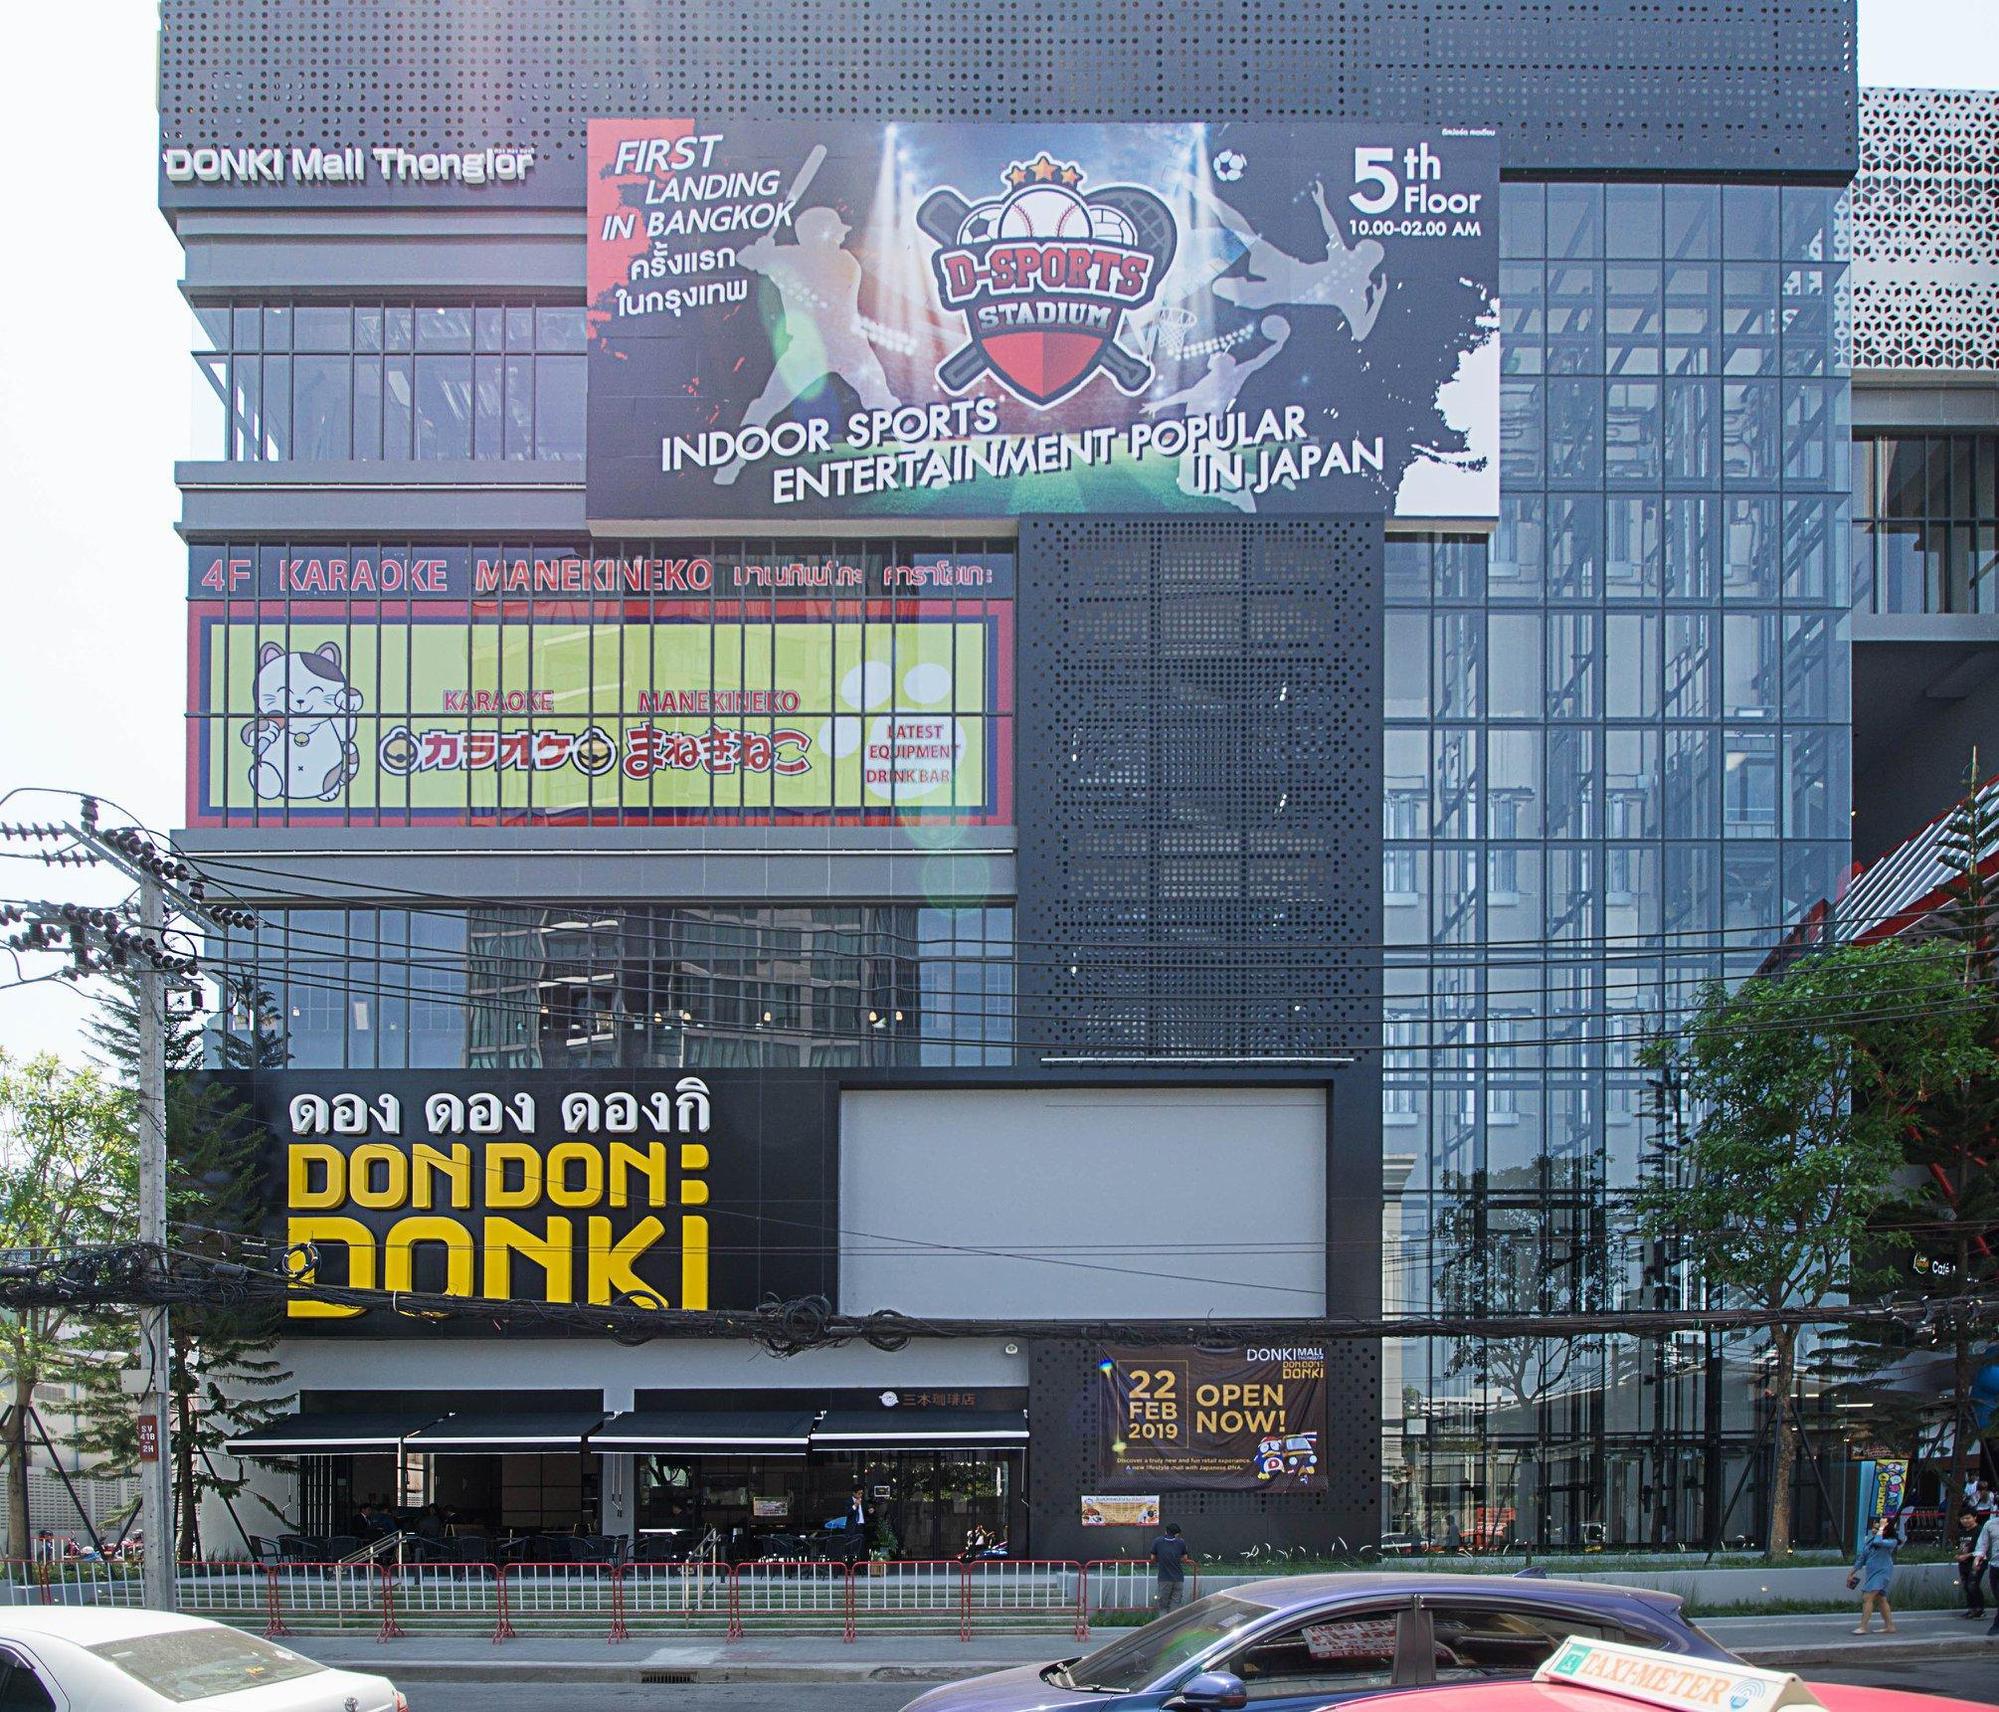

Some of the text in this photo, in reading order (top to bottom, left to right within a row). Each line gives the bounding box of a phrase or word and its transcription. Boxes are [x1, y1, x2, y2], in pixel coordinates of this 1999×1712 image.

[165, 148, 534, 184] DONKI Mall Thonglor
[614, 134, 724, 174] FIRST
[645, 169, 781, 204] LANDING
[1404, 184, 1482, 214] Floor
[602, 200, 797, 241] IN BANGKOK
[1349, 220, 1482, 237] 10.00-02.00 AM
[630, 241, 736, 281] ครั้งแรก
[943, 246, 1150, 299] D-SPORTS
[615, 279, 748, 317] ในกรุงเทพ
[977, 302, 1114, 329] STADIUM
[661, 398, 999, 472] INDOOR SPORTS
[772, 405, 1308, 505] ENTERTAINMENT POPULAR
[1198, 436, 1385, 494] IN JAPAN
[200, 558, 714, 592] 4F KARAOKE MANEKINEKO
[443, 688, 801, 714] KARAOKE MANEKINEKO
[887, 724, 944, 739] LATEST
[419, 721, 813, 781] カラオケ まねきねこ
[865, 769, 951, 784] DRINK BAR
[288, 1076, 711, 1135] ดอง ดอง ดองกิ
[287, 1215, 710, 1319] DONKI
[1246, 1347, 1324, 1362] DONKI MALL
[1128, 1369, 1177, 1400] 22
[1282, 1368, 1324, 1380] DONKI
[1128, 1402, 1178, 1420] FEB
[1195, 1384, 1284, 1407] OPEN
[1128, 1423, 1178, 1440] 2019
[1195, 1410, 1286, 1434] NOW!
[1580, 1651, 1732, 1705] TAXI-METER
